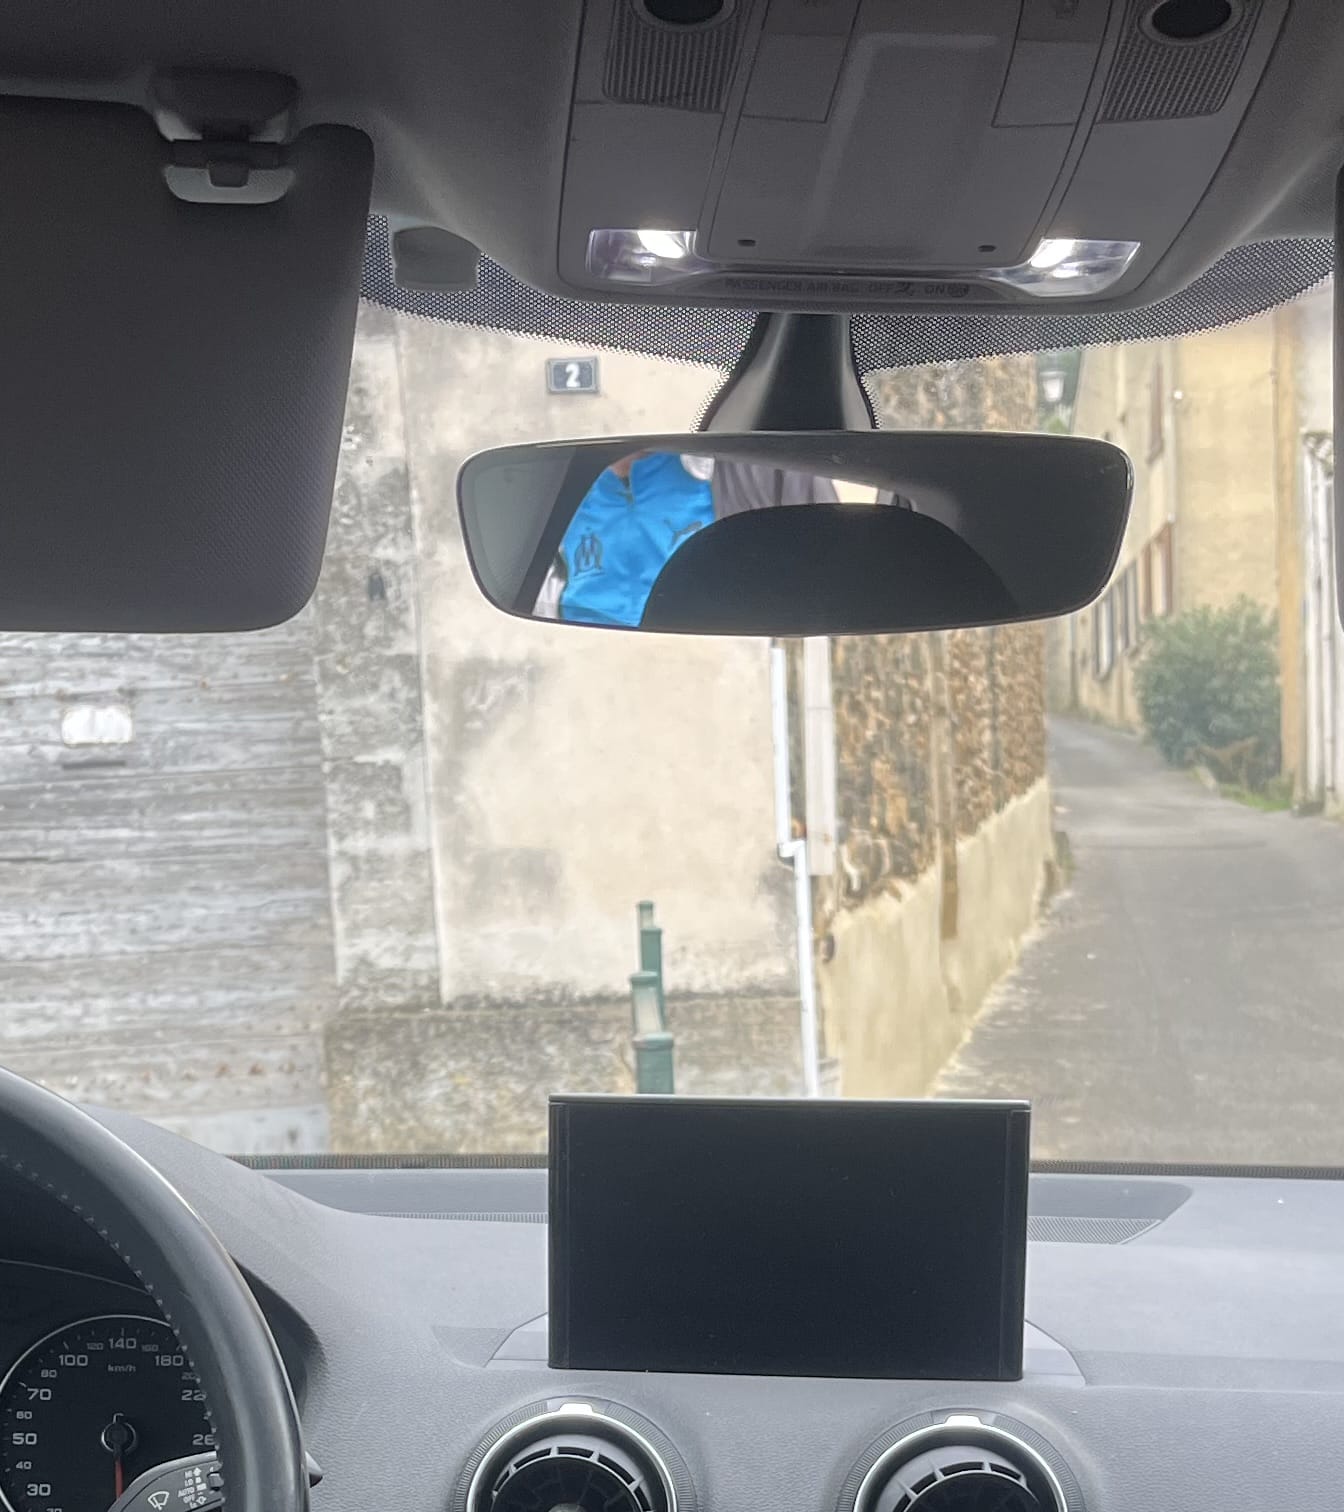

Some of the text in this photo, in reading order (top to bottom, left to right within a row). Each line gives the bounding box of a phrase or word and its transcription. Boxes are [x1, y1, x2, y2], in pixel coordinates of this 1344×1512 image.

[565, 362, 581, 388] 2
[108, 1337, 137, 1349] 140
[58, 1354, 89, 1366] 100
[154, 1355, 184, 1367] 180
[41, 1369, 57, 1378] 80
[107, 1363, 137, 1373] km/h
[27, 1388, 52, 1401] 70
[16, 1410, 33, 1420] 60
[12, 1432, 37, 1445] 50
[15, 1461, 32, 1470] 40
[26, 1484, 51, 1497] 30
